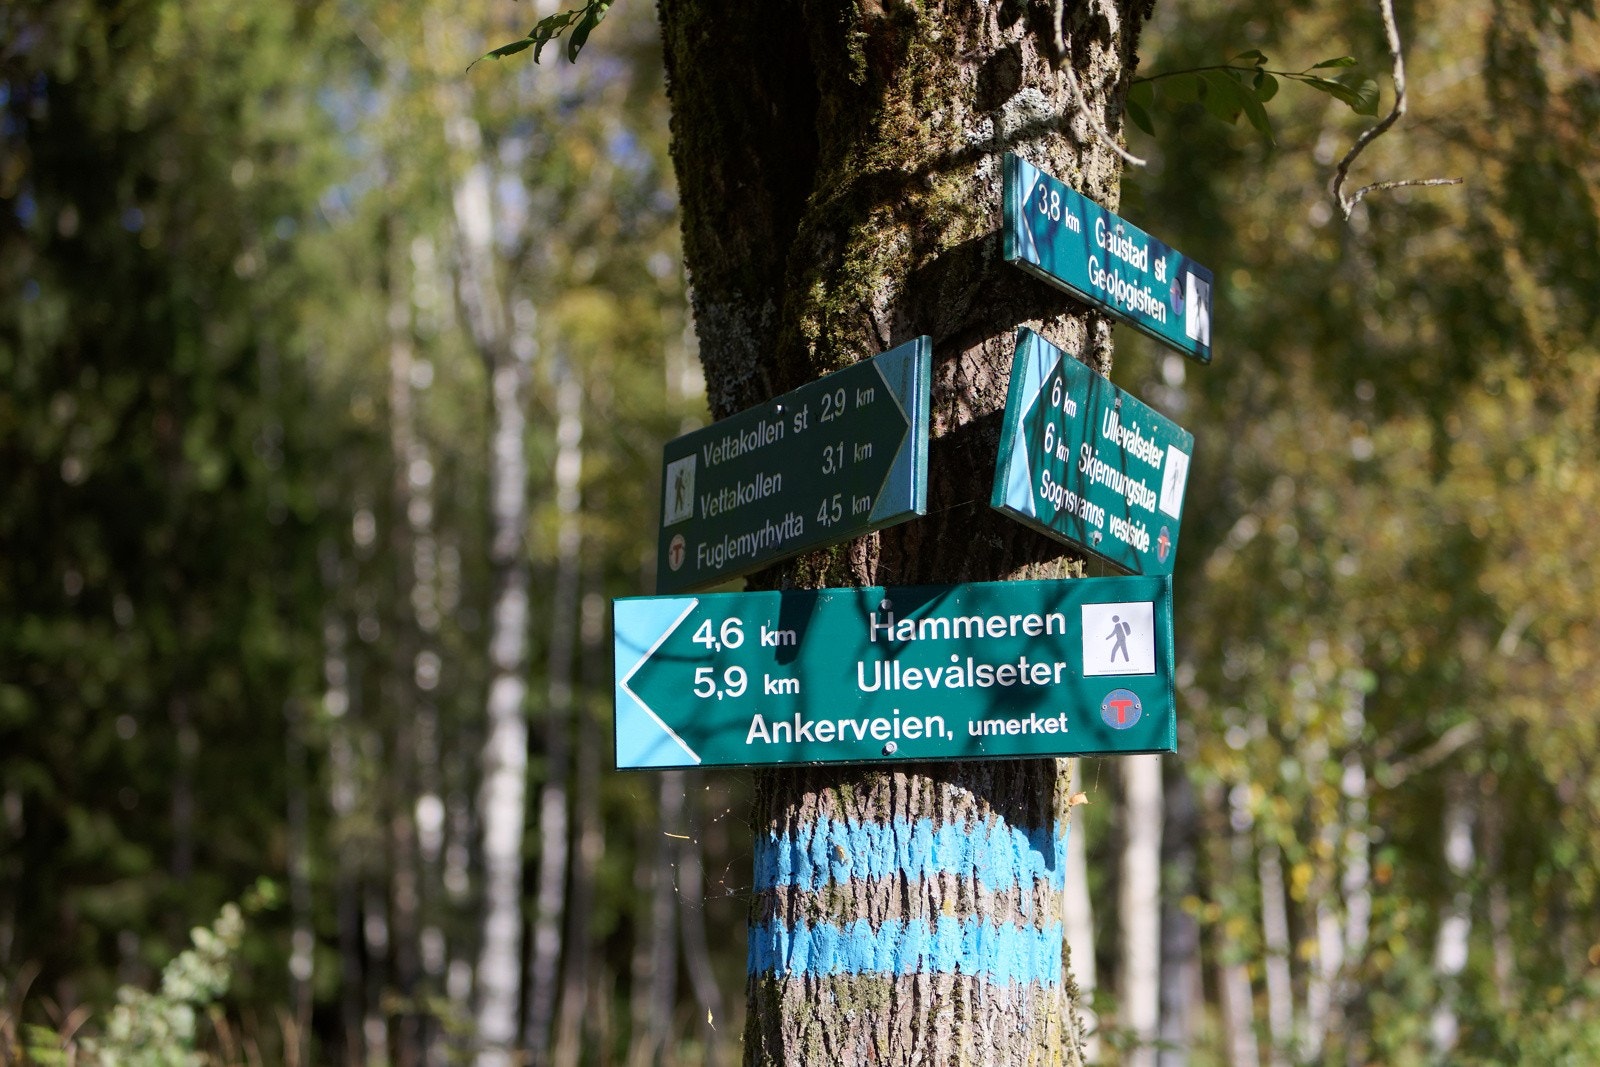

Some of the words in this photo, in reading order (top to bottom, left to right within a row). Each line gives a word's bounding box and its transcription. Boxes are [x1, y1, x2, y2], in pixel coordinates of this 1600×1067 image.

[1038, 183, 1060, 222] 3,8
[1065, 207, 1080, 234] km
[1095, 217, 1148, 273] Gaustad
[1154, 255, 1167, 284] st
[703, 419, 785, 468] Vettakollen
[793, 404, 808, 434] st
[820, 387, 846, 423] 2,9
[856, 386, 875, 408] km
[1051, 376, 1062, 408] 6
[1063, 392, 1077, 418] km
[1102, 406, 1164, 470] Ullevålseter
[700, 472, 782, 520] Vettakollen
[821, 441, 844, 475] 3,1
[854, 442, 872, 463] km
[1044, 422, 1055, 453] 6
[1056, 438, 1070, 463] km
[1078, 442, 1157, 514] Skjennungstua
[697, 511, 803, 570] Fuglemyrhytta
[816, 493, 842, 527] 4,5
[852, 494, 871, 516] km
[1040, 469, 1105, 529] Sognsvanns
[1109, 513, 1150, 554] vestside
[692, 617, 744, 652] 4,6
[760, 625, 796, 647] km
[869, 611, 1066, 643] Hammeren
[692, 665, 748, 700] 5,9
[764, 674, 800, 695] km
[857, 654, 1067, 692] Ullevålseter
[745, 709, 953, 745] Ankerveien,
[968, 712, 1068, 737] umerket
